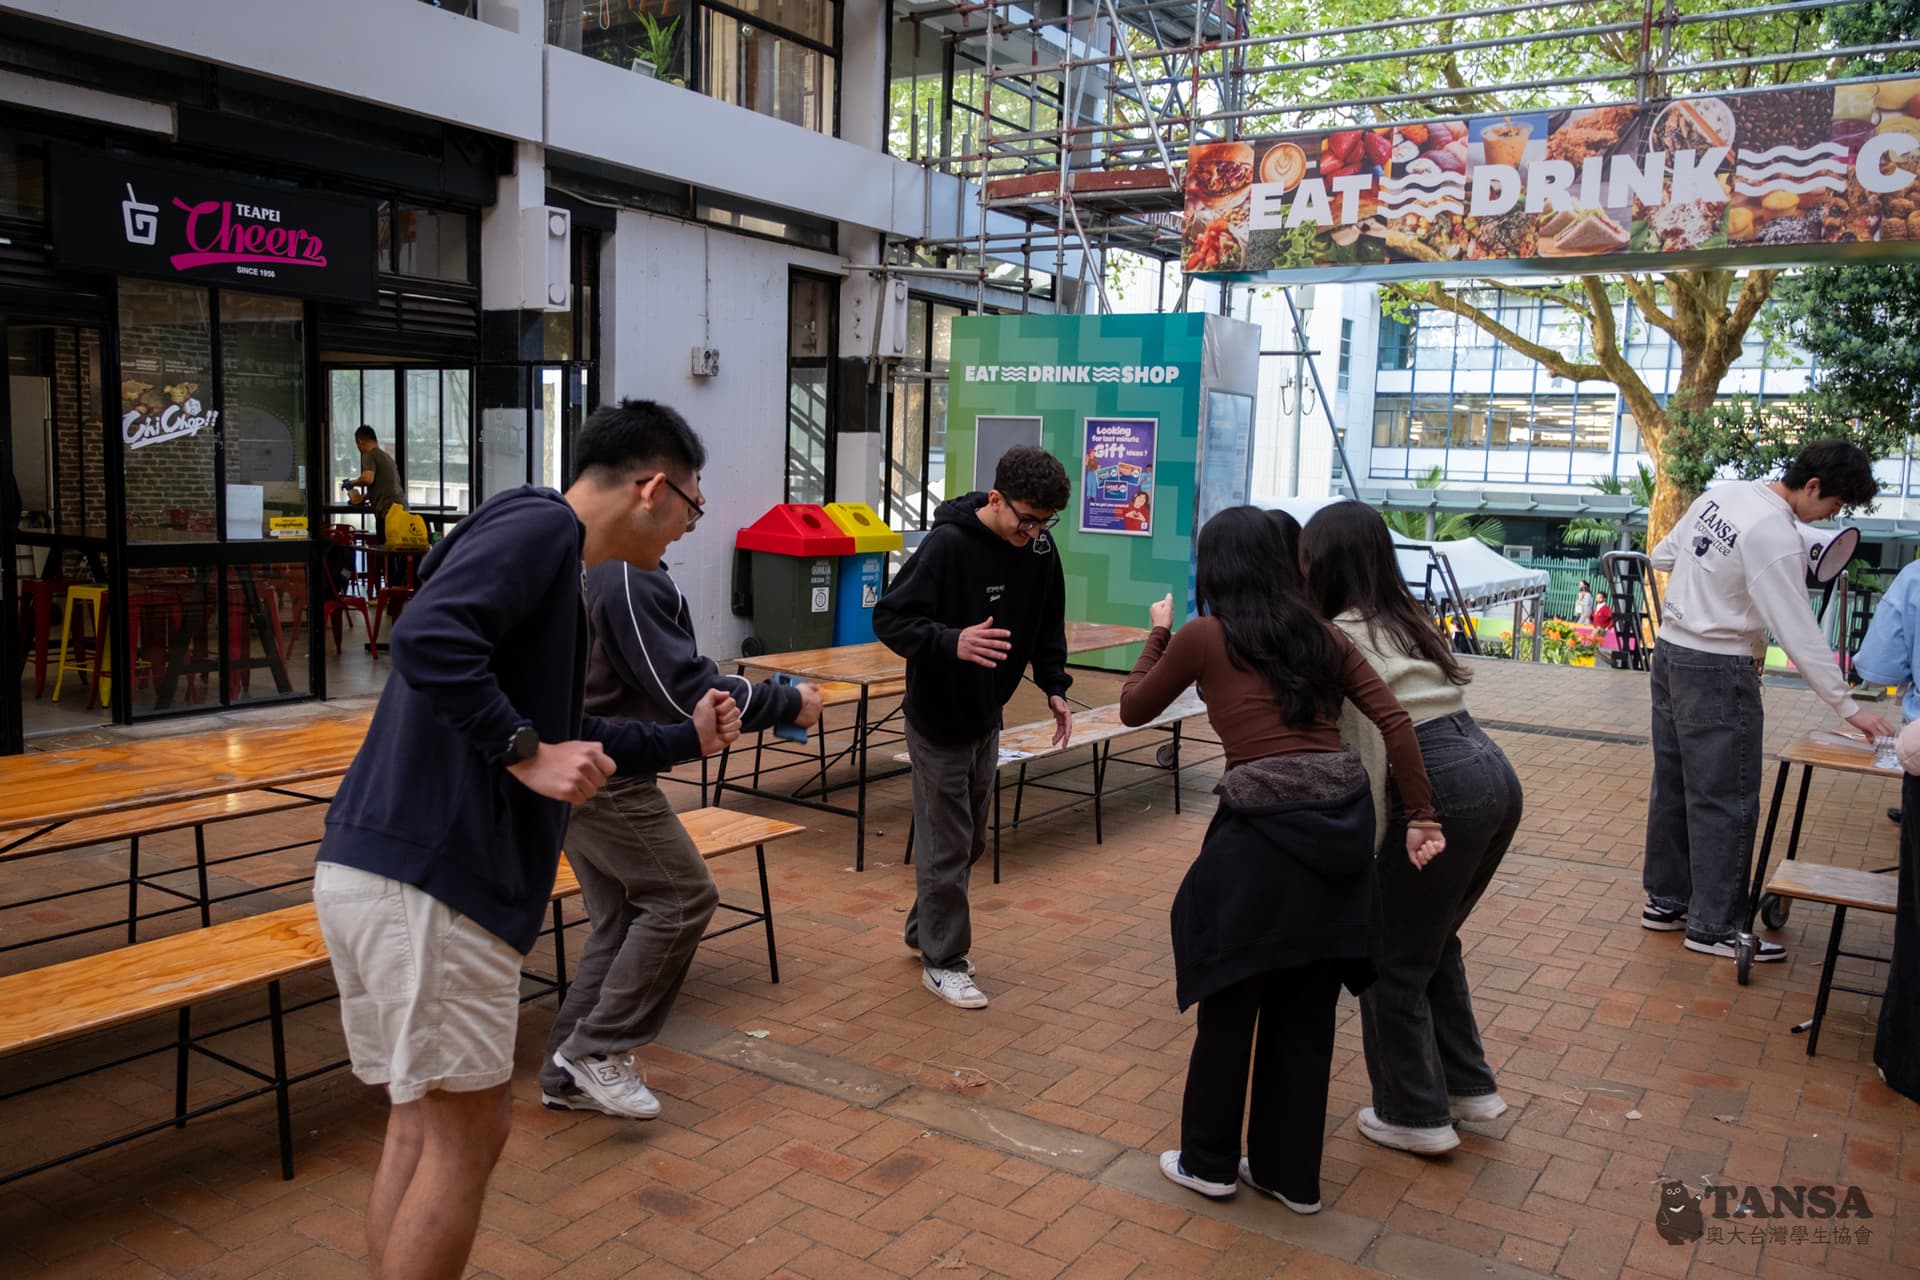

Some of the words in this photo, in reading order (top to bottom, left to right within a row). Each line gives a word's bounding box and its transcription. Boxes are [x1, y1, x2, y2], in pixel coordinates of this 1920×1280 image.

[1249, 173, 1373, 231] EAT
[1470, 146, 1731, 217] DRINK
[1856, 132, 1919, 193] C
[235, 203, 281, 223] TEAPEI
[236, 265, 258, 276] SINCE
[965, 365, 999, 382] EAT
[1028, 366, 1091, 383] DRINK
[1121, 366, 1180, 383] SHOP
[1096, 426, 1132, 437] Looking
[1094, 443, 1126, 459] Gift
[1699, 500, 1738, 549] TANSA
